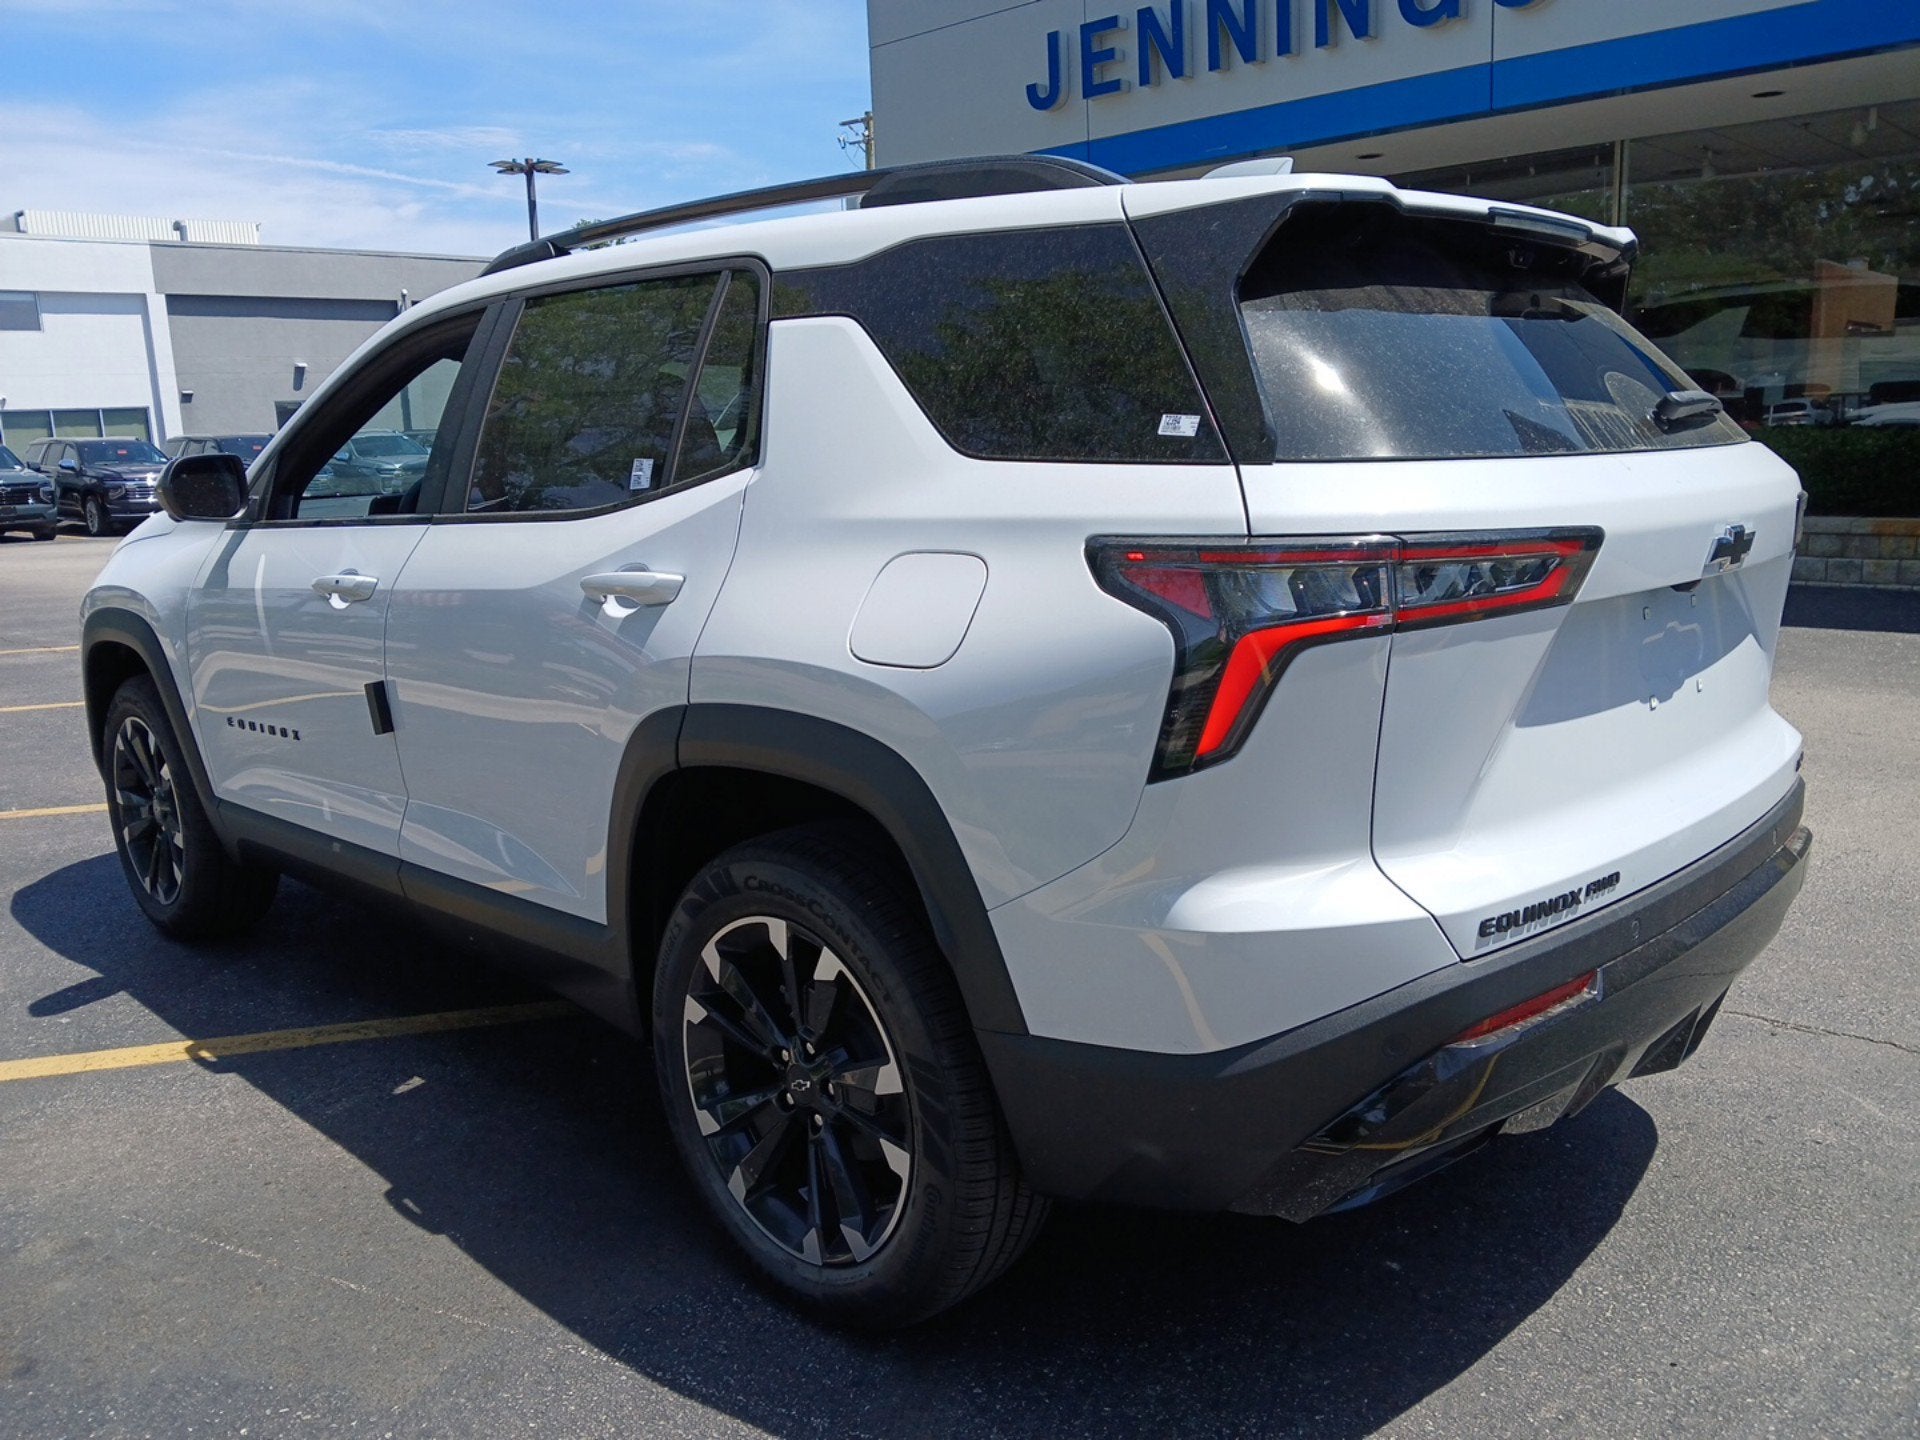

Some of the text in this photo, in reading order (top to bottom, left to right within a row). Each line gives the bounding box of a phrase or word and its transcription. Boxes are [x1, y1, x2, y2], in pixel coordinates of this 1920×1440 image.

[1026, 0, 1539, 111] JENNIN
[227, 717, 301, 741] EQUINOX
[1479, 887, 1583, 938] EQUINOX
